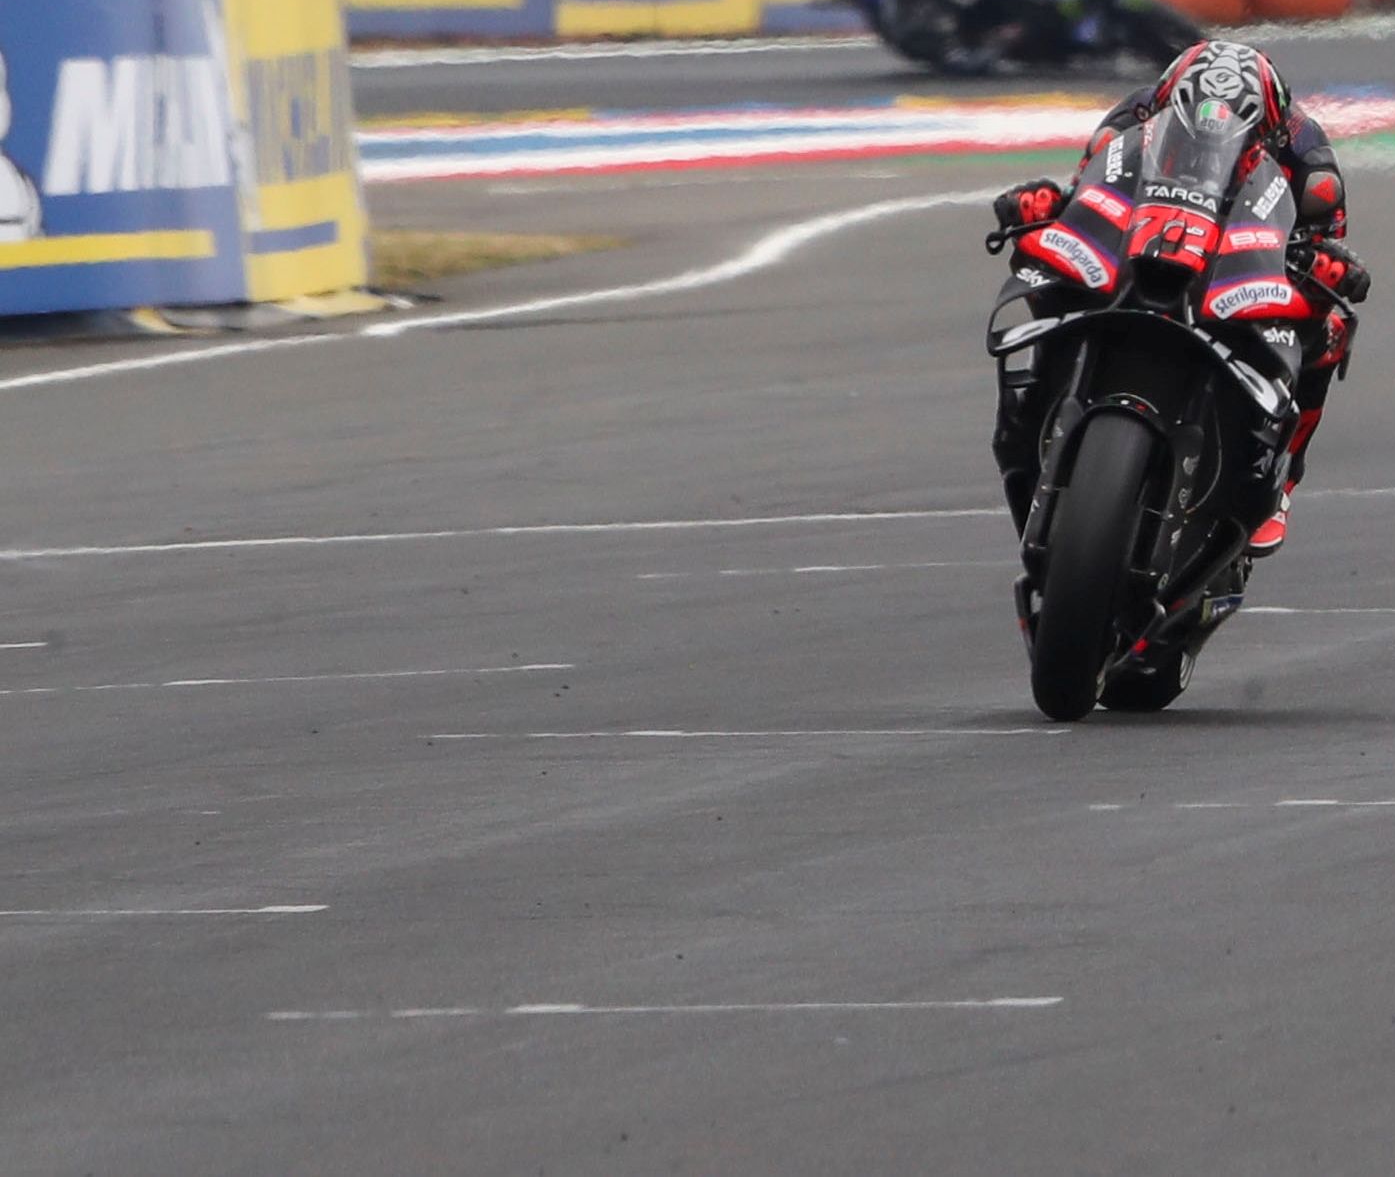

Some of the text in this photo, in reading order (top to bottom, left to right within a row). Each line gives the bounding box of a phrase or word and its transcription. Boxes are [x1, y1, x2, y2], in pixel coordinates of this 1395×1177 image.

[1145, 185, 1217, 213] TARGA
[1229, 230, 1279, 246] BS
[1044, 231, 1103, 284] sterilgarda
[1016, 267, 1050, 288] sky
[1214, 284, 1287, 314] sterilgarda
[1263, 327, 1296, 347] sky
